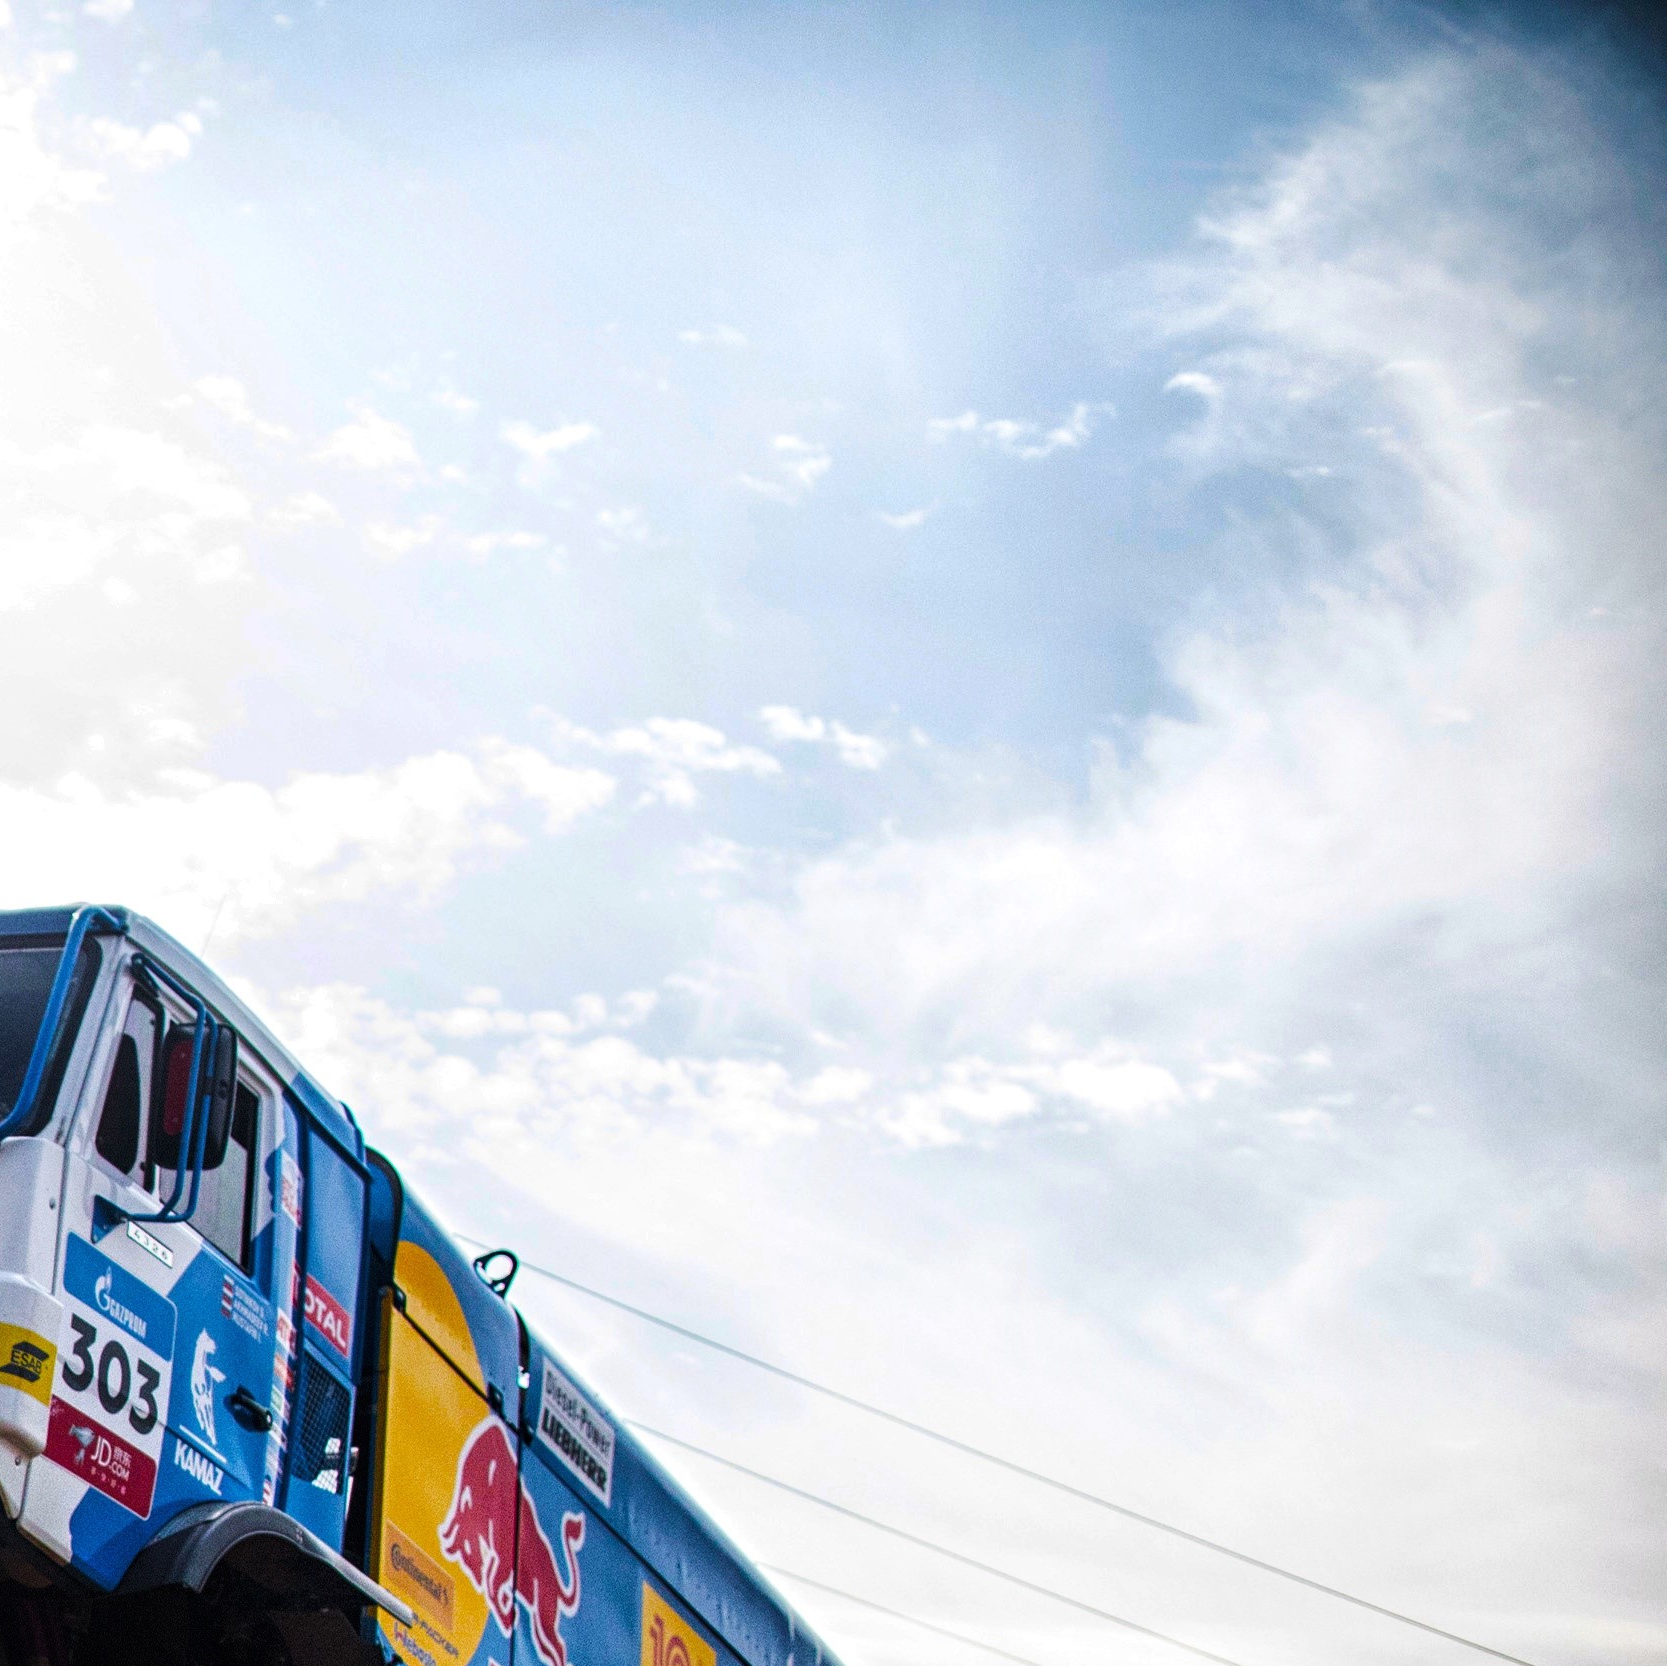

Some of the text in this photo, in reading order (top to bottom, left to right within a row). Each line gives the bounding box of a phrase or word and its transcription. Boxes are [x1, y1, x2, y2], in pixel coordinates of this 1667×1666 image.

[11, 1349, 42, 1374] ESAB
[62, 1312, 161, 1436] 303
[546, 1369, 612, 1457] Diesel-Power
[91, 1434, 112, 1467] JD
[109, 1461, 130, 1482] .COM
[174, 1438, 224, 1497] KAMAZ
[541, 1406, 608, 1493] LIEBHERR
